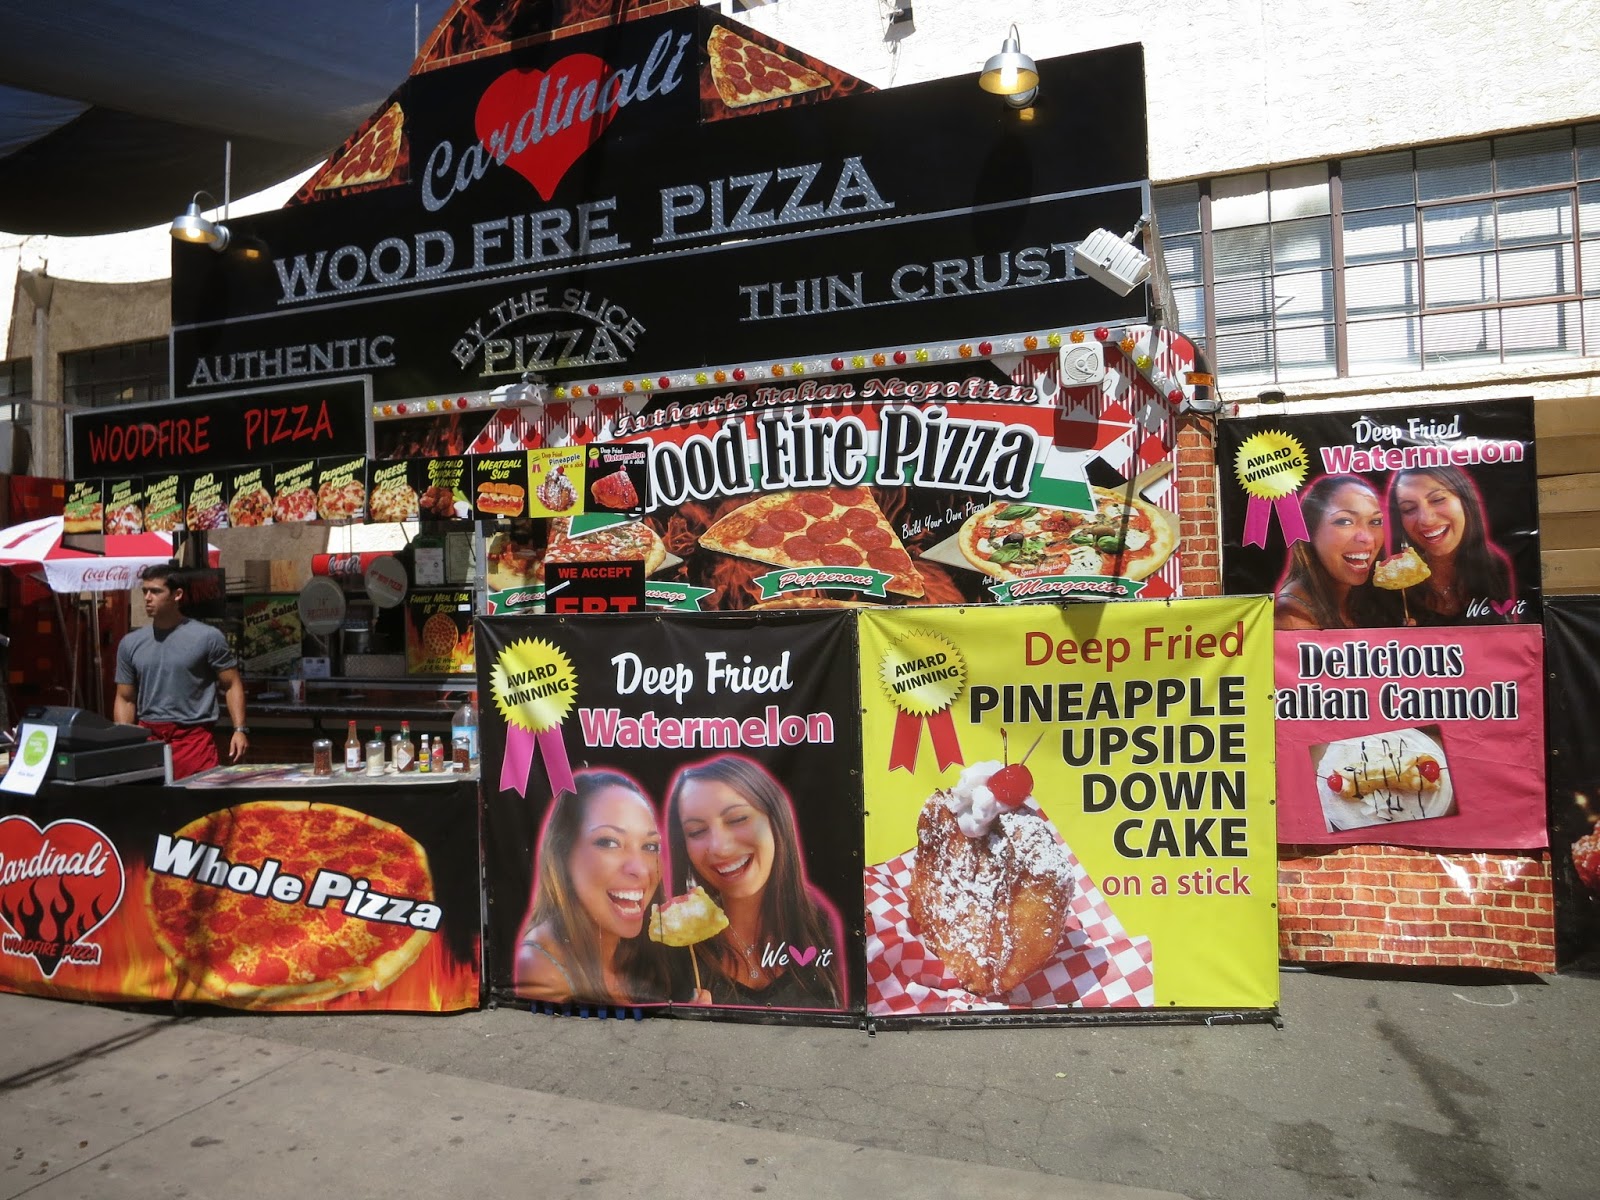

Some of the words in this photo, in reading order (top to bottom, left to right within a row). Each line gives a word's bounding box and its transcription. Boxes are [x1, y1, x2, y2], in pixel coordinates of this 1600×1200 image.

[421, 28, 693, 213] Cardinali
[274, 228, 456, 304] WOOD
[471, 196, 631, 272] FIRE
[653, 155, 895, 244] PIZZA
[739, 271, 865, 321] THIN
[891, 240, 1090, 301] CRUST
[450, 320, 484, 371] BY
[489, 286, 550, 329] THE
[562, 286, 647, 353] SLICE
[186, 334, 397, 387] AUTHENTIC
[478, 326, 628, 377] PIZZA
[613, 392, 748, 437] Authentic
[754, 378, 854, 407] Italian
[862, 376, 1038, 403] Neopolitan
[89, 415, 210, 464] WOODFIRE
[244, 400, 334, 451] PIZZA
[1352, 416, 1402, 444] Deep
[1408, 414, 1461, 440] Fried
[427, 459, 464, 470] BUFFALO
[477, 458, 522, 472] MEATBALL
[549, 453, 581, 466] Pineapple
[603, 451, 646, 463] Watermelon
[645, 415, 753, 509] ood
[758, 407, 868, 490] Fire
[875, 403, 1040, 498] Pizza
[1246, 446, 1292, 469] AWARD
[1320, 436, 1524, 475] Watermelon
[193, 472, 214, 491] BBQ
[233, 468, 262, 489] VEGGIE
[273, 460, 315, 486] PEPPERONI
[319, 456, 365, 484] PEPPERONI
[331, 473, 354, 491] PIZZA
[374, 461, 408, 483] CHEESE
[428, 469, 464, 480] CHICKEN
[431, 478, 461, 488] WINGS
[490, 469, 511, 480] SUB
[1244, 456, 1303, 484] WINNING
[190, 481, 223, 503] CHICKEN
[238, 480, 263, 498] PIZZA
[281, 476, 313, 498] SAUSAGE
[380, 475, 408, 493] PIZZA
[197, 495, 220, 512] PIZZA
[902, 519, 922, 540] Build
[924, 514, 942, 532] Your
[945, 507, 963, 524] Own
[558, 567, 578, 579] WE
[581, 566, 632, 579] ACCEPT
[778, 568, 874, 589] Pepperoni
[454, 591, 469, 602] DEAL
[505, 591, 546, 606] Chees
[645, 589, 687, 602] usage
[1010, 578, 1128, 599] Margarita
[246, 612, 270, 627] Pizza
[271, 600, 299, 618] Salad
[1466, 597, 1490, 618] We
[1510, 599, 1527, 615] it
[1024, 631, 1131, 674] Deep
[1145, 620, 1245, 663] Fried
[1298, 640, 1465, 680] Delicious
[506, 663, 558, 690] AWARD
[611, 651, 694, 705] Deep
[705, 651, 794, 695] Fried
[895, 652, 948, 679] AWARD
[503, 677, 571, 708] WINNING
[892, 666, 960, 695] WINNING
[970, 676, 1246, 725] PINEAPPLE
[1274, 683, 1371, 722] alian
[1380, 681, 1518, 721] Cannoli
[578, 705, 835, 749] Watermelon
[1061, 723, 1246, 767] UPSIDE
[1082, 771, 1246, 814] DOWN
[1113, 818, 1249, 859] CAKE
[151, 834, 303, 903] Whole
[307, 870, 442, 932] Pizza
[1102, 875, 1141, 896] on
[1150, 875, 1168, 896] a
[1177, 867, 1251, 896] stick
[4, 937, 57, 957] WOODFIRE
[61, 943, 99, 961] PIZZA
[761, 942, 790, 969] We
[815, 948, 833, 967] it
